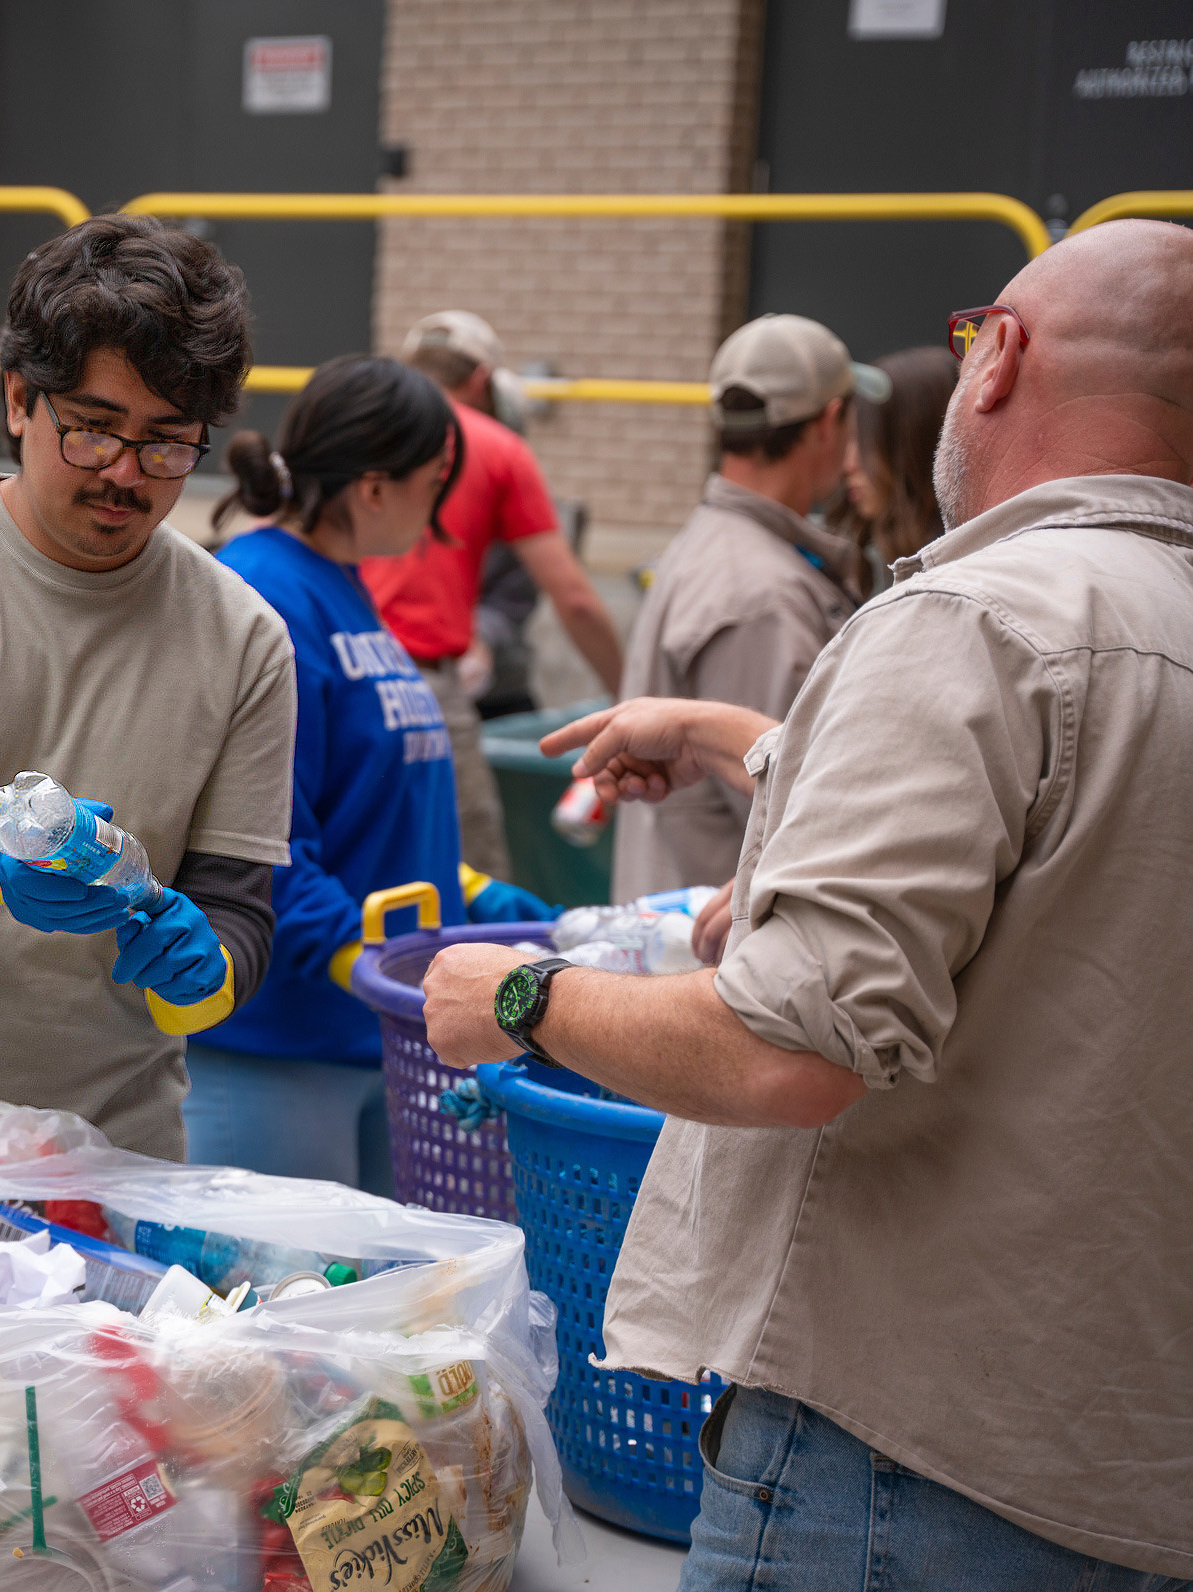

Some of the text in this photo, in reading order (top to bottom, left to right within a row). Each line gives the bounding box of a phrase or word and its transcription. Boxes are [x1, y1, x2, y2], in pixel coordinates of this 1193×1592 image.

[398, 1471, 426, 1507] SPICY
[329, 1498, 444, 1592] Miss Vickie's
